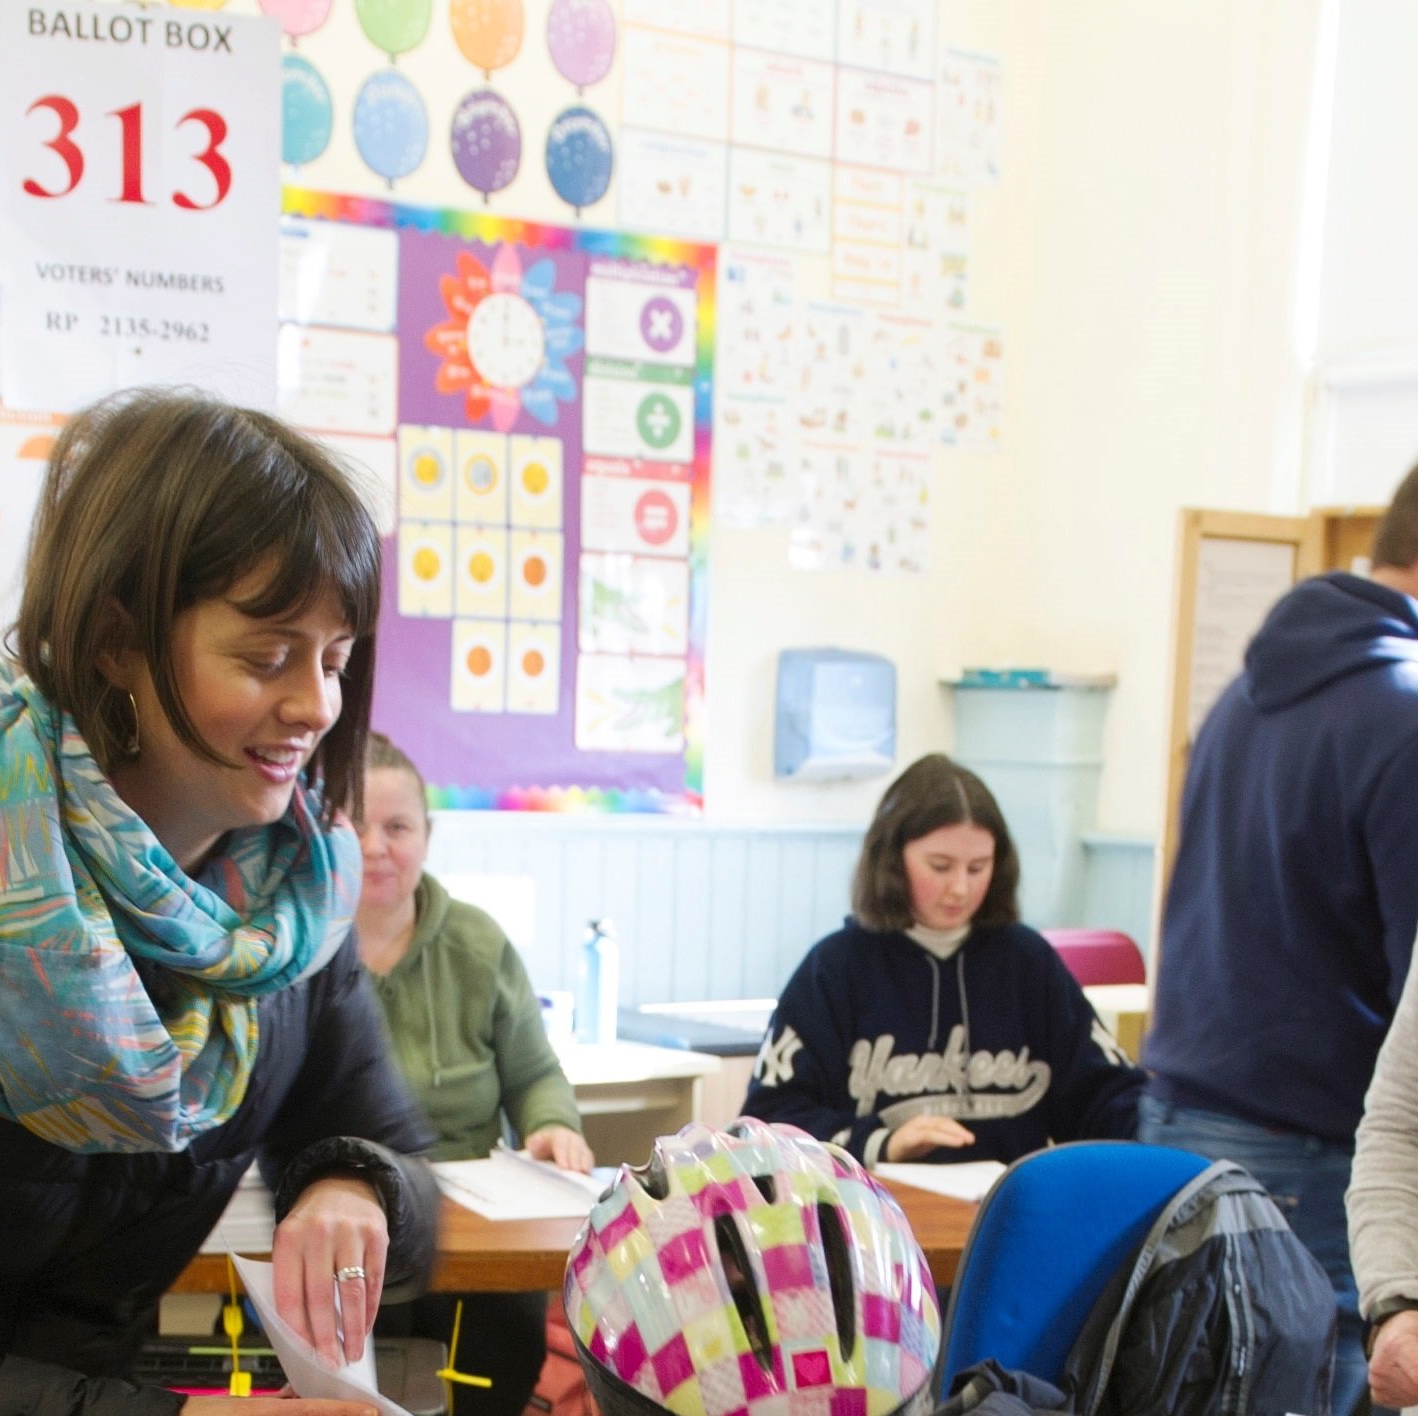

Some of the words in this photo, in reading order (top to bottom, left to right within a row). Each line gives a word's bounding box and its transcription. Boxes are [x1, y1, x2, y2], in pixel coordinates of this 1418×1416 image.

[28, 8, 153, 46] BALLOT
[164, 21, 234, 54] BOX
[22, 93, 233, 212] 313
[35, 260, 119, 285] VOTERS'
[126, 271, 225, 293] NUMBERS
[46, 310, 79, 331] RP
[99, 314, 209, 343] 2135-2962
[847, 1023, 1031, 1118] Yankees
